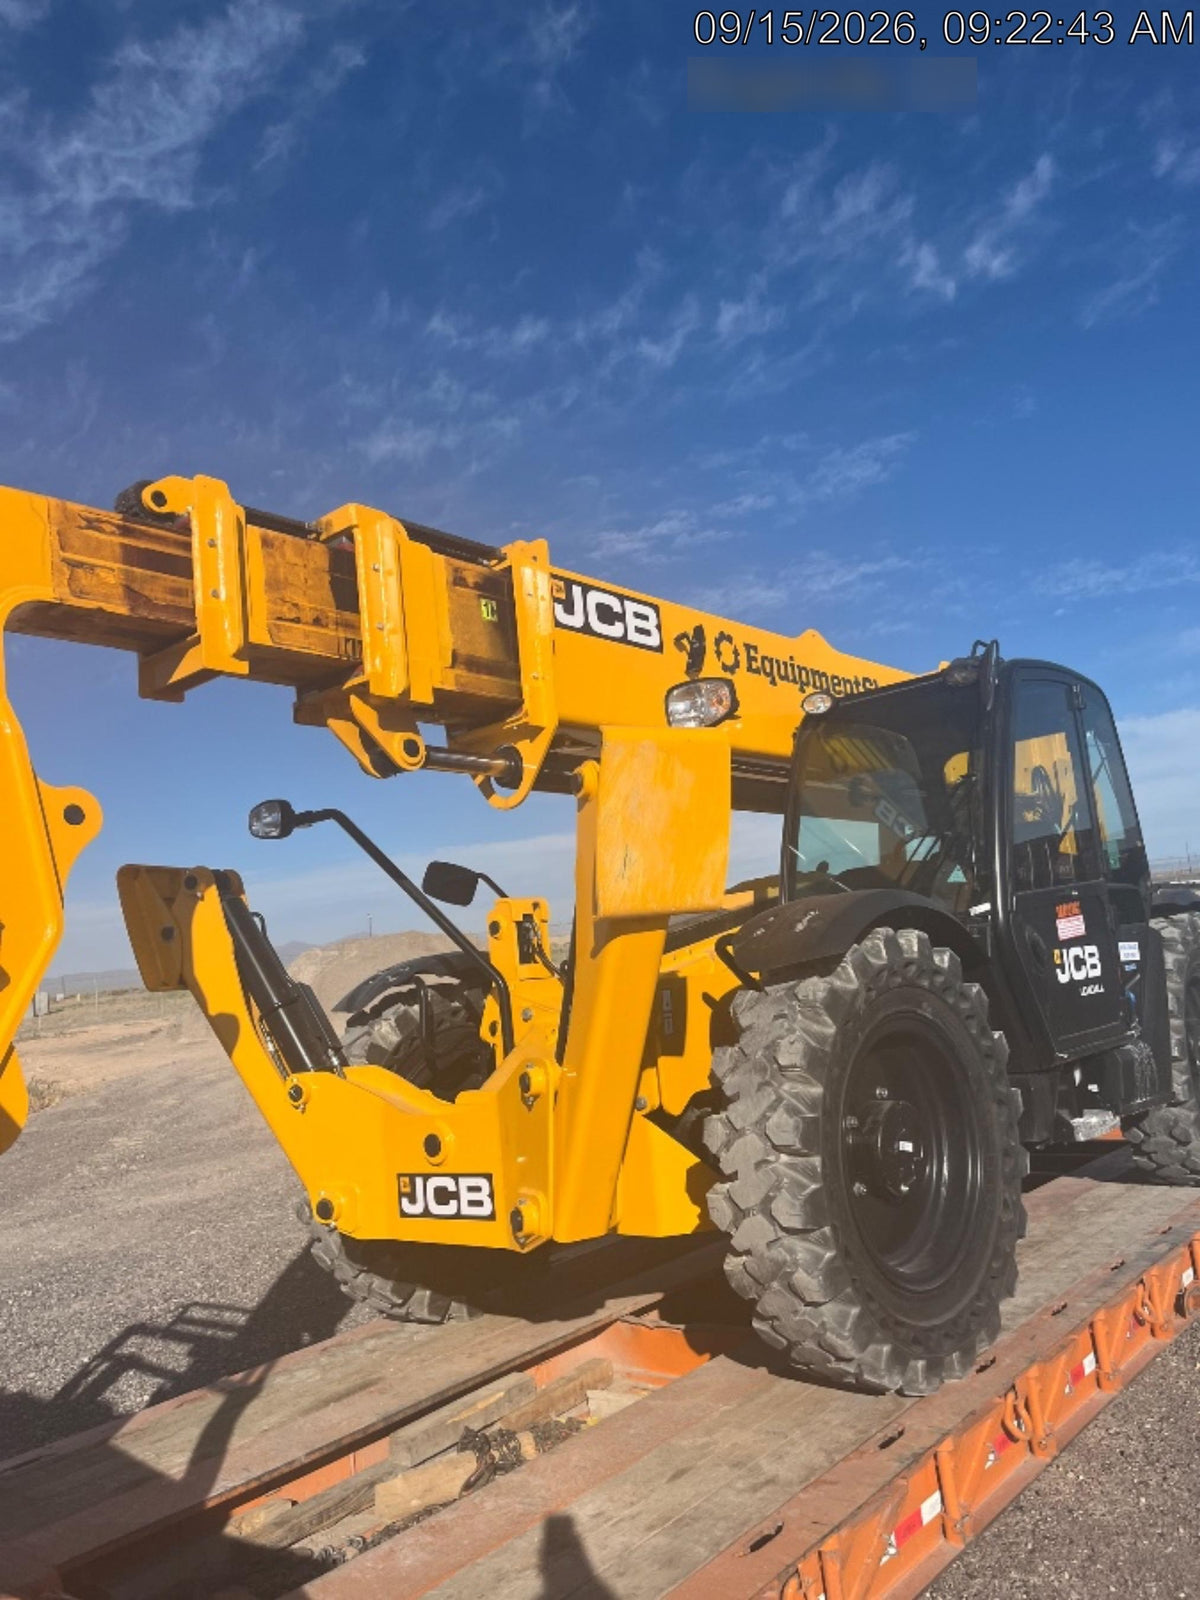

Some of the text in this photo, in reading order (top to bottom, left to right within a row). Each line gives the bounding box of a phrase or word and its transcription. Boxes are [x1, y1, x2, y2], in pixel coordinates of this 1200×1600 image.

[554, 584, 661, 648] JCB
[1056, 945, 1101, 984] JCB
[401, 1176, 493, 1216] JCB
